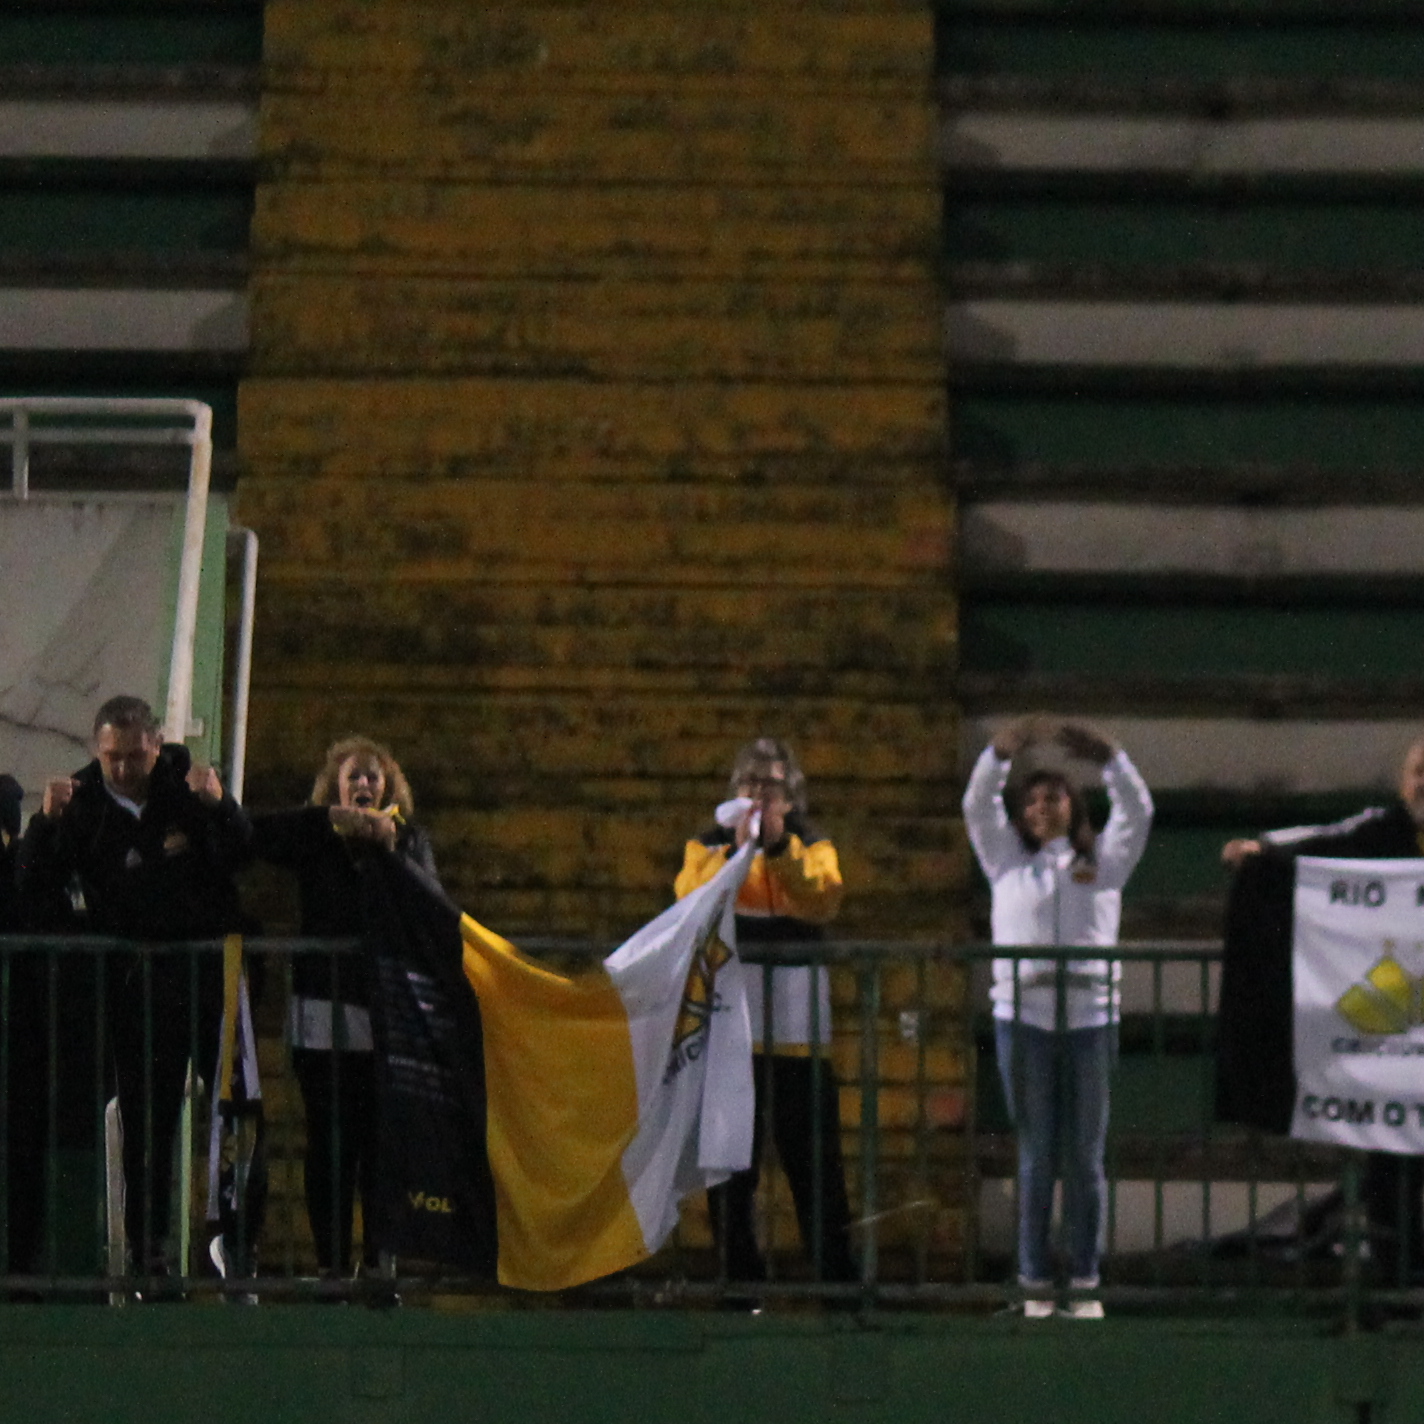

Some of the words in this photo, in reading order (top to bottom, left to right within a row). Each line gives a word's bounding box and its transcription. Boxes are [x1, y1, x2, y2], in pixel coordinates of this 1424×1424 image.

[1329, 879, 1387, 908] RIO
[1302, 1095, 1375, 1126] COM
[1383, 1100, 1407, 1128] O
